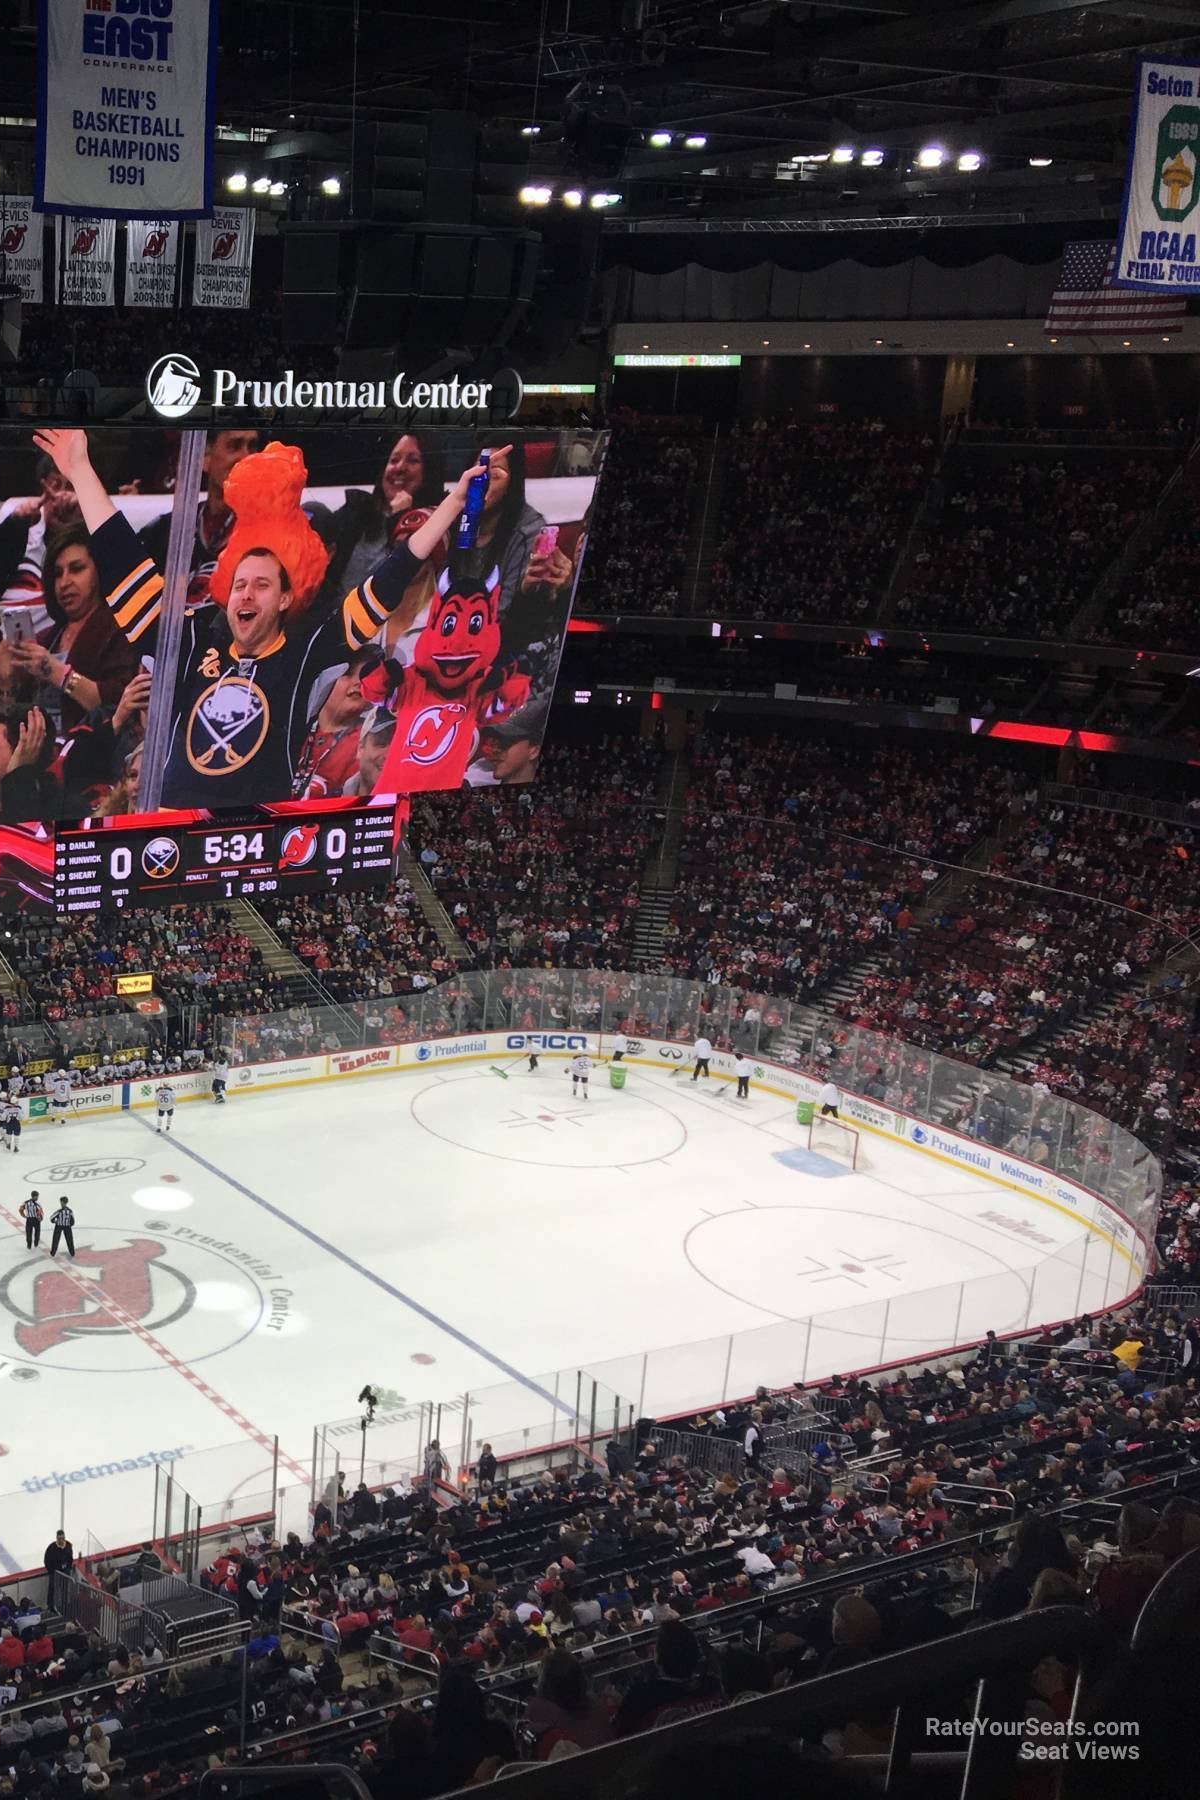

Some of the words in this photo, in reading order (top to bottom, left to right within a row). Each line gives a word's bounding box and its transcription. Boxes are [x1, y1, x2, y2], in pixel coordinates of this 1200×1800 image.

[83, 14, 173, 61] EAST
[83, 59, 174, 73] CONFERENCE
[1147, 71, 1192, 97] Seton
[101, 86, 157, 111] MEN'S
[72, 109, 185, 138] BASKETBALL
[1168, 121, 1198, 141] 1989
[75, 135, 180, 162] CHAMPIONS
[108, 165, 145, 186] 1991
[211, 218, 241, 231] DEVILS
[1127, 260, 1165, 282] FINAL
[201, 281, 243, 293] CHAMPIONS
[624, 354, 682, 367] Heineken
[700, 354, 731, 367] Deck
[213, 369, 385, 408] Prudential
[393, 372, 493, 409] Center
[365, 815, 394, 826] LOVEJOY
[68, 841, 96, 851] DAHLIN
[204, 832, 264, 865] 5:34
[326, 828, 347, 860] 0
[363, 844, 385, 854] BRATT
[68, 854, 102, 866] HUNWICK
[110, 847, 132, 880] 0
[68, 870, 97, 880] SHEARY
[185, 873, 209, 881] PENALTY
[250, 867, 272, 875] PENALTY
[225, 882, 233, 897] 1
[242, 882, 255, 893] 28
[259, 880, 278, 891] 2:00
[331, 877, 338, 887] 7
[435, 1040, 487, 1057] Prudential
[506, 1034, 588, 1050] GEICO
[59, 1084, 66, 1094] 9
[930, 1135, 992, 1171] Prudential
[49, 1160, 127, 1182] Ford
[1000, 1161, 1044, 1189] Walmart
[170, 1226, 284, 1281] Prudential
[266, 1288, 294, 1332] Center
[21, 1446, 186, 1494] ticketmaster
